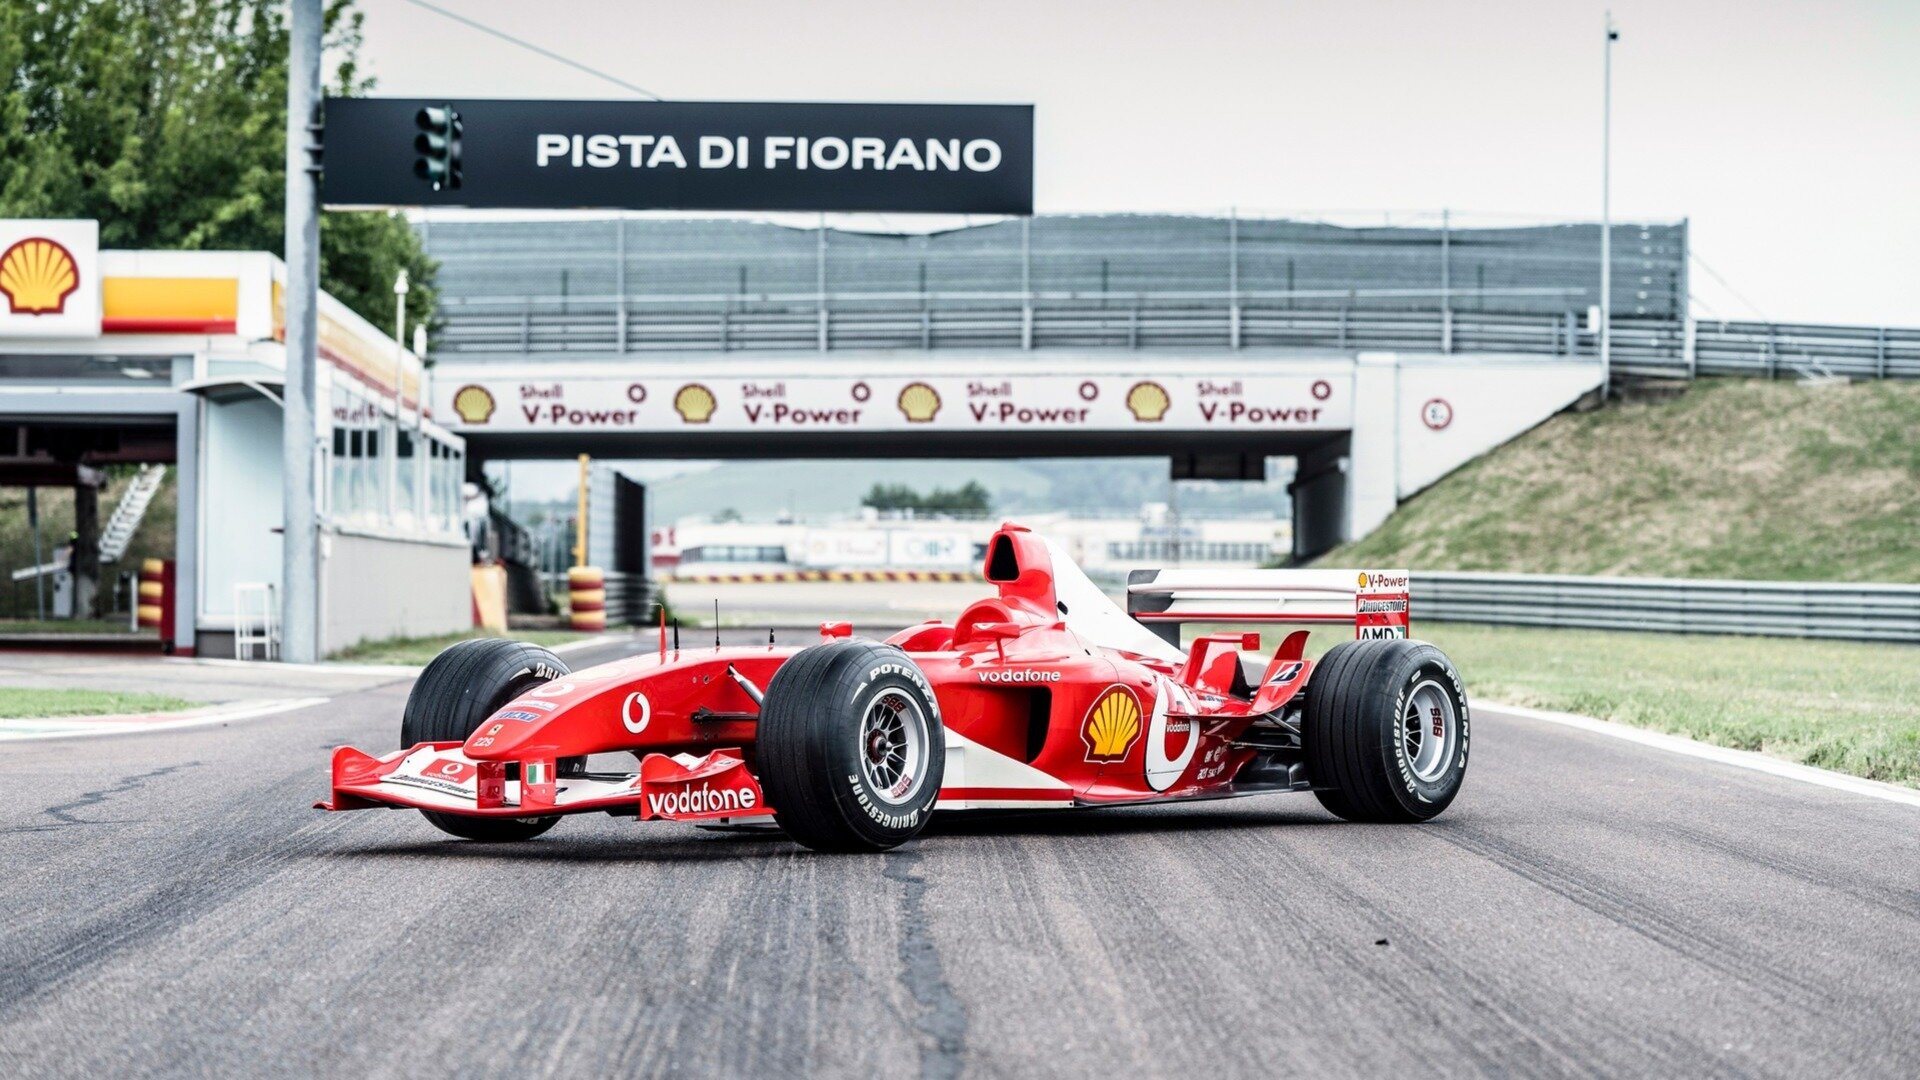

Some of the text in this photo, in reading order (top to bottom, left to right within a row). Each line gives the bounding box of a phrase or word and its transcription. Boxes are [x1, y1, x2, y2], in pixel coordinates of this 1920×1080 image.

[536, 134, 1002, 172] PISTA DI FIORANO
[519, 384, 563, 399] Shell
[742, 383, 785, 398] Shell
[967, 382, 1012, 397] Shell
[1197, 382, 1242, 396] Shell
[522, 404, 638, 425] V-Power
[743, 403, 862, 424] V-Power
[968, 402, 1090, 423] V-Power
[1198, 402, 1322, 422] V-Power
[1368, 574, 1408, 588] V-Power
[1359, 600, 1407, 613] BRIDGESTONE
[1361, 627, 1395, 640] AMD
[978, 668, 1061, 682] vodafone
[869, 663, 938, 718] POTENZA
[1166, 721, 1190, 733] vodafone
[1446, 668, 1469, 769] POTENZA
[648, 781, 756, 814] vodafone
[848, 773, 919, 829] BRIDGESTONE
